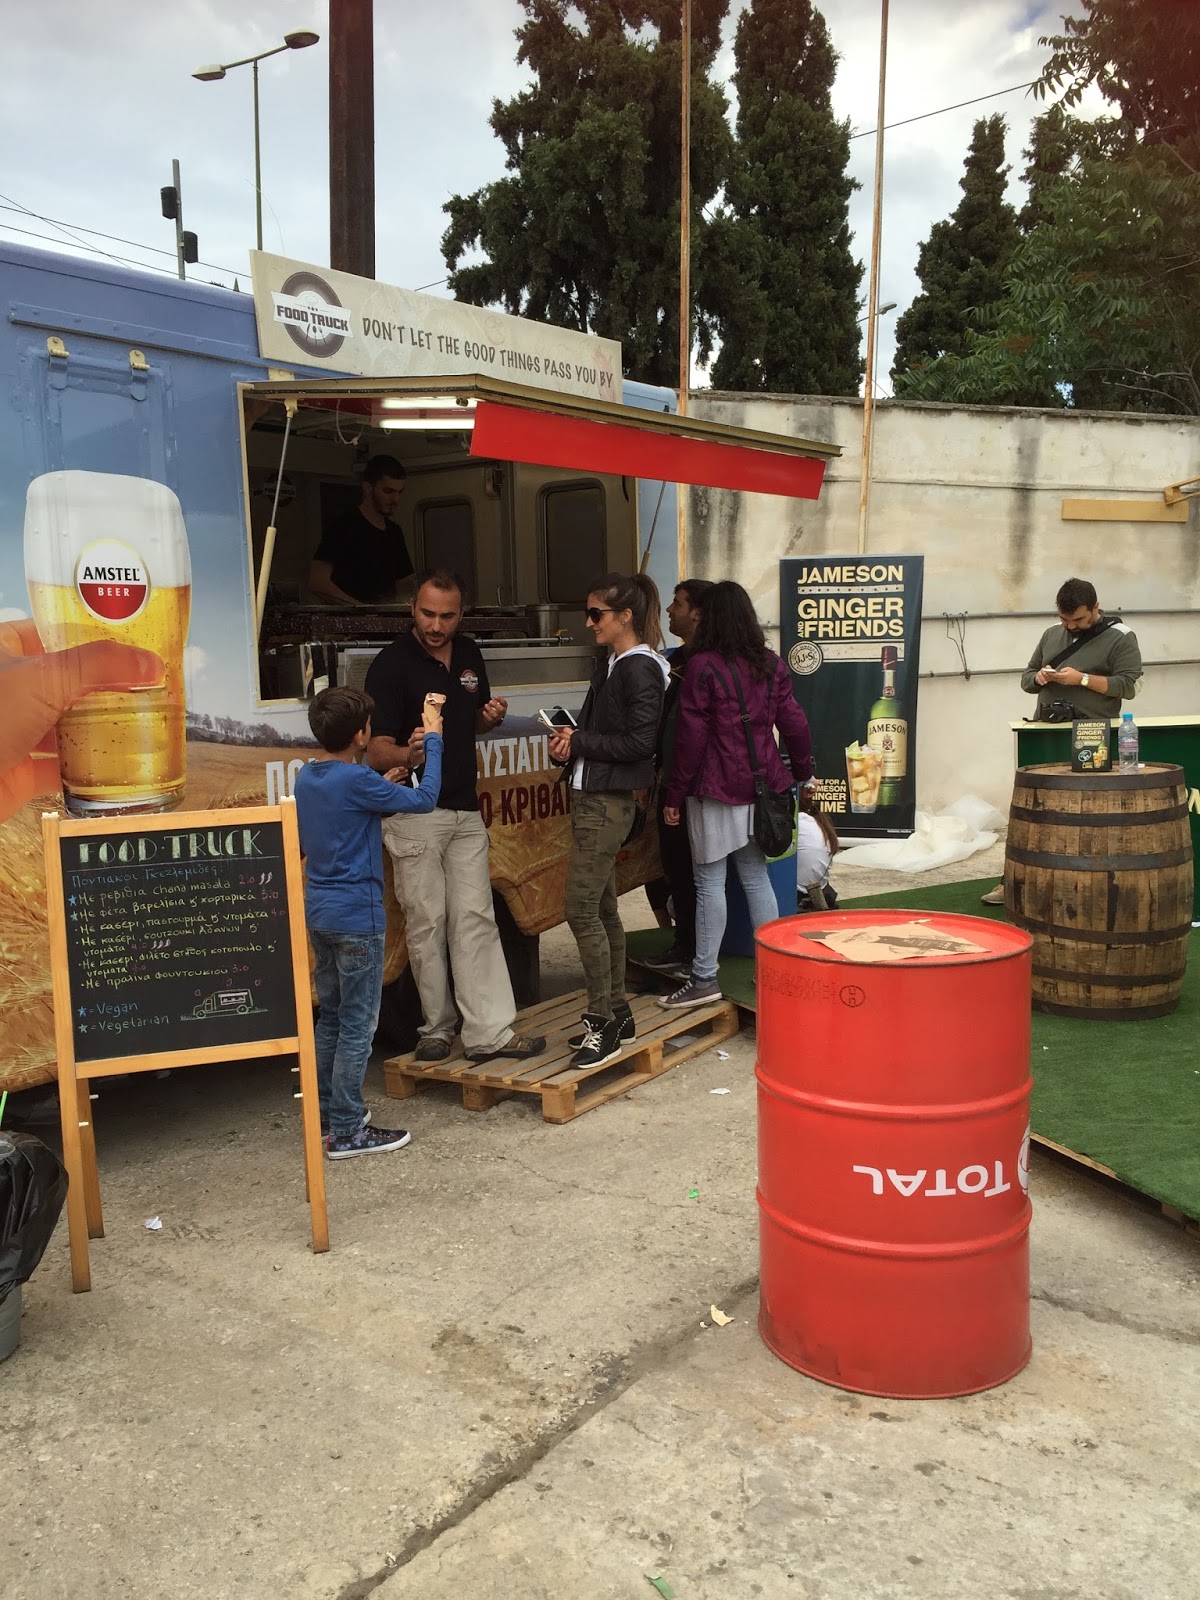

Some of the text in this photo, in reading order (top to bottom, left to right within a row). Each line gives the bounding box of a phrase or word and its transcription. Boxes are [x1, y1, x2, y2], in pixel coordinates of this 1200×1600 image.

[277, 305, 349, 332] FOOD TRUCK
[362, 317, 613, 388] DON'T LET THE GOOD THINGS PASS YOU BY
[83, 566, 140, 582] AMSTEL
[797, 565, 904, 584] JAMESON
[97, 587, 130, 597] BEER
[797, 597, 904, 620] GINGER
[804, 618, 904, 638] FRIENDS
[869, 723, 907, 736] JAMESON
[820, 801, 846, 813] IME
[79, 829, 263, 864] FOOD TRUCK
[78, 892, 95, 906] Με
[153, 884, 187, 895] chana
[191, 878, 231, 891] masala
[80, 908, 96, 922] Με
[80, 924, 96, 935] Με
[81, 936, 96, 947] Με
[82, 959, 96, 970] Με
[85, 978, 101, 989] Με
[96, 1002, 138, 1018] Vegan
[98, 1015, 170, 1034] Vegetarian
[852, 1160, 1011, 1197] TOTAL
